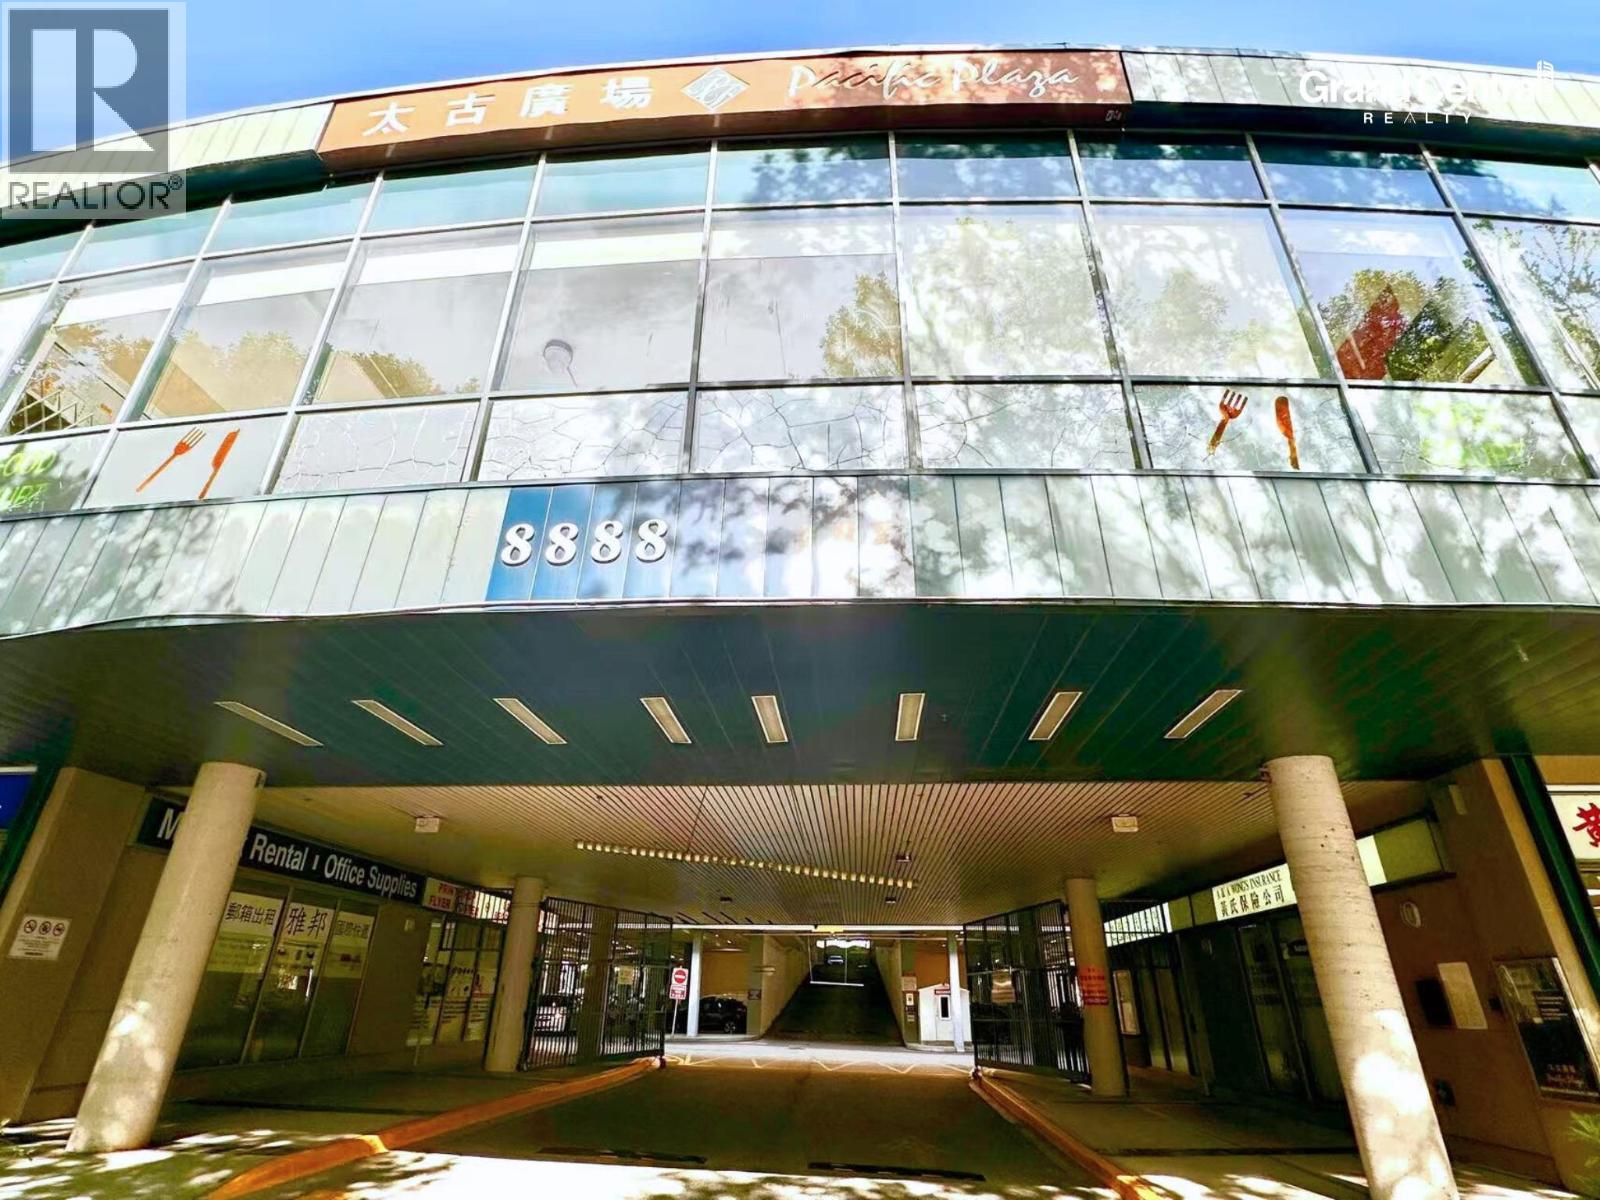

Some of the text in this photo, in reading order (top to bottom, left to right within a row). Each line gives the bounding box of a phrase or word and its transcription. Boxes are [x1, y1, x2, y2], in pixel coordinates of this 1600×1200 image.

[787, 58, 1078, 99] Pacific Plaza
[362, 77, 653, 137] 太古廣場
[501, 518, 669, 566] 8888
[250, 833, 309, 872] Rental
[324, 854, 365, 885] Office
[367, 865, 418, 899] Supplies
[285, 906, 328, 939] 雅邦
